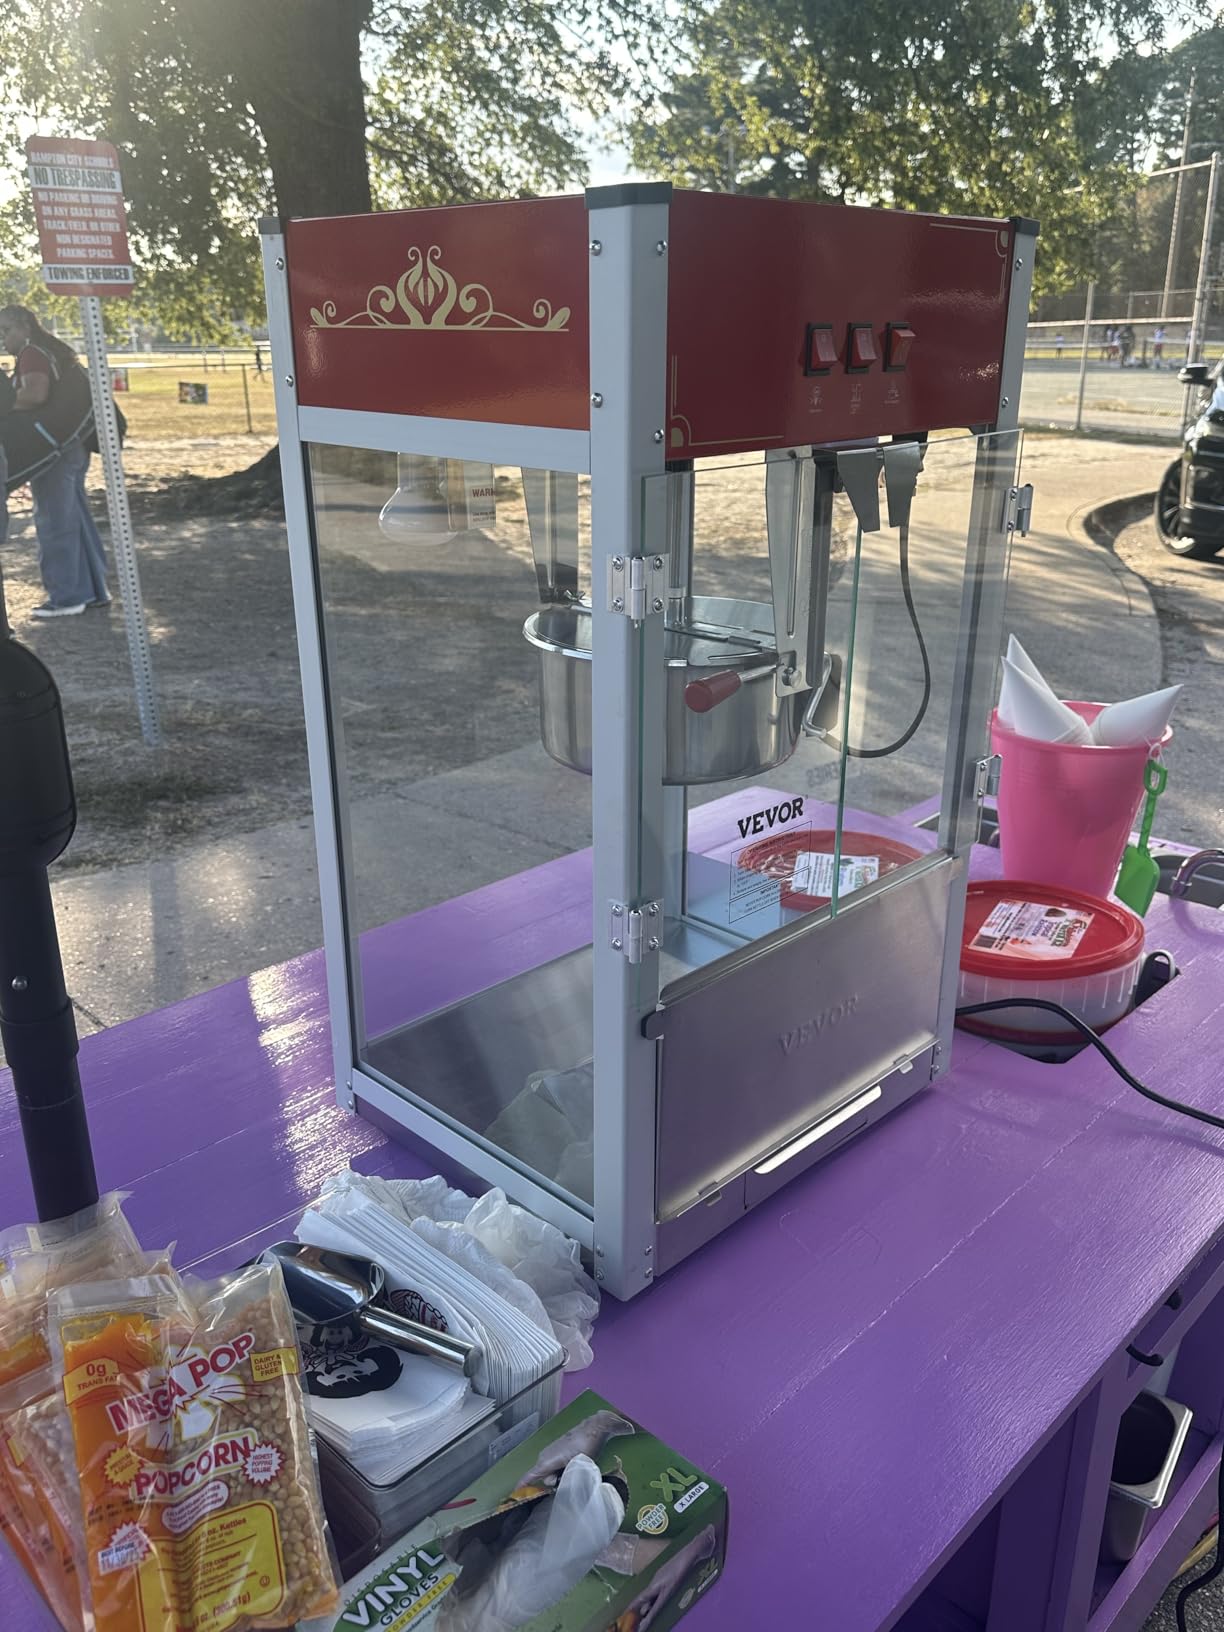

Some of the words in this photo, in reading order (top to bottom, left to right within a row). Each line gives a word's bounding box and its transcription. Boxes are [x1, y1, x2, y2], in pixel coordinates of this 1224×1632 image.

[34, 167, 49, 186] NO
[51, 168, 117, 190] TRESPASSING
[48, 266, 84, 281] TOWING
[86, 267, 130, 281] ENFORCED
[737, 796, 804, 839] VEVOR
[778, 994, 859, 1053] VEVOR
[85, 1363, 106, 1378] 0g
[254, 1356, 273, 1364] DAIRY
[255, 1360, 282, 1371] GLUTEN
[260, 1367, 279, 1376] FREE
[78, 1377, 103, 1391] TRANS
[104, 1375, 118, 1386] FAT
[108, 1377, 187, 1431] MEGA
[188, 1334, 254, 1388] POP
[135, 1436, 253, 1498] POPCORN
[649, 1467, 698, 1502] XL
[679, 1500, 687, 1509] X
[637, 1504, 665, 1531] POWDER
[648, 1515, 664, 1529] FREE
[342, 1549, 445, 1626] VINYL
[380, 1573, 439, 1627] GLOVES
